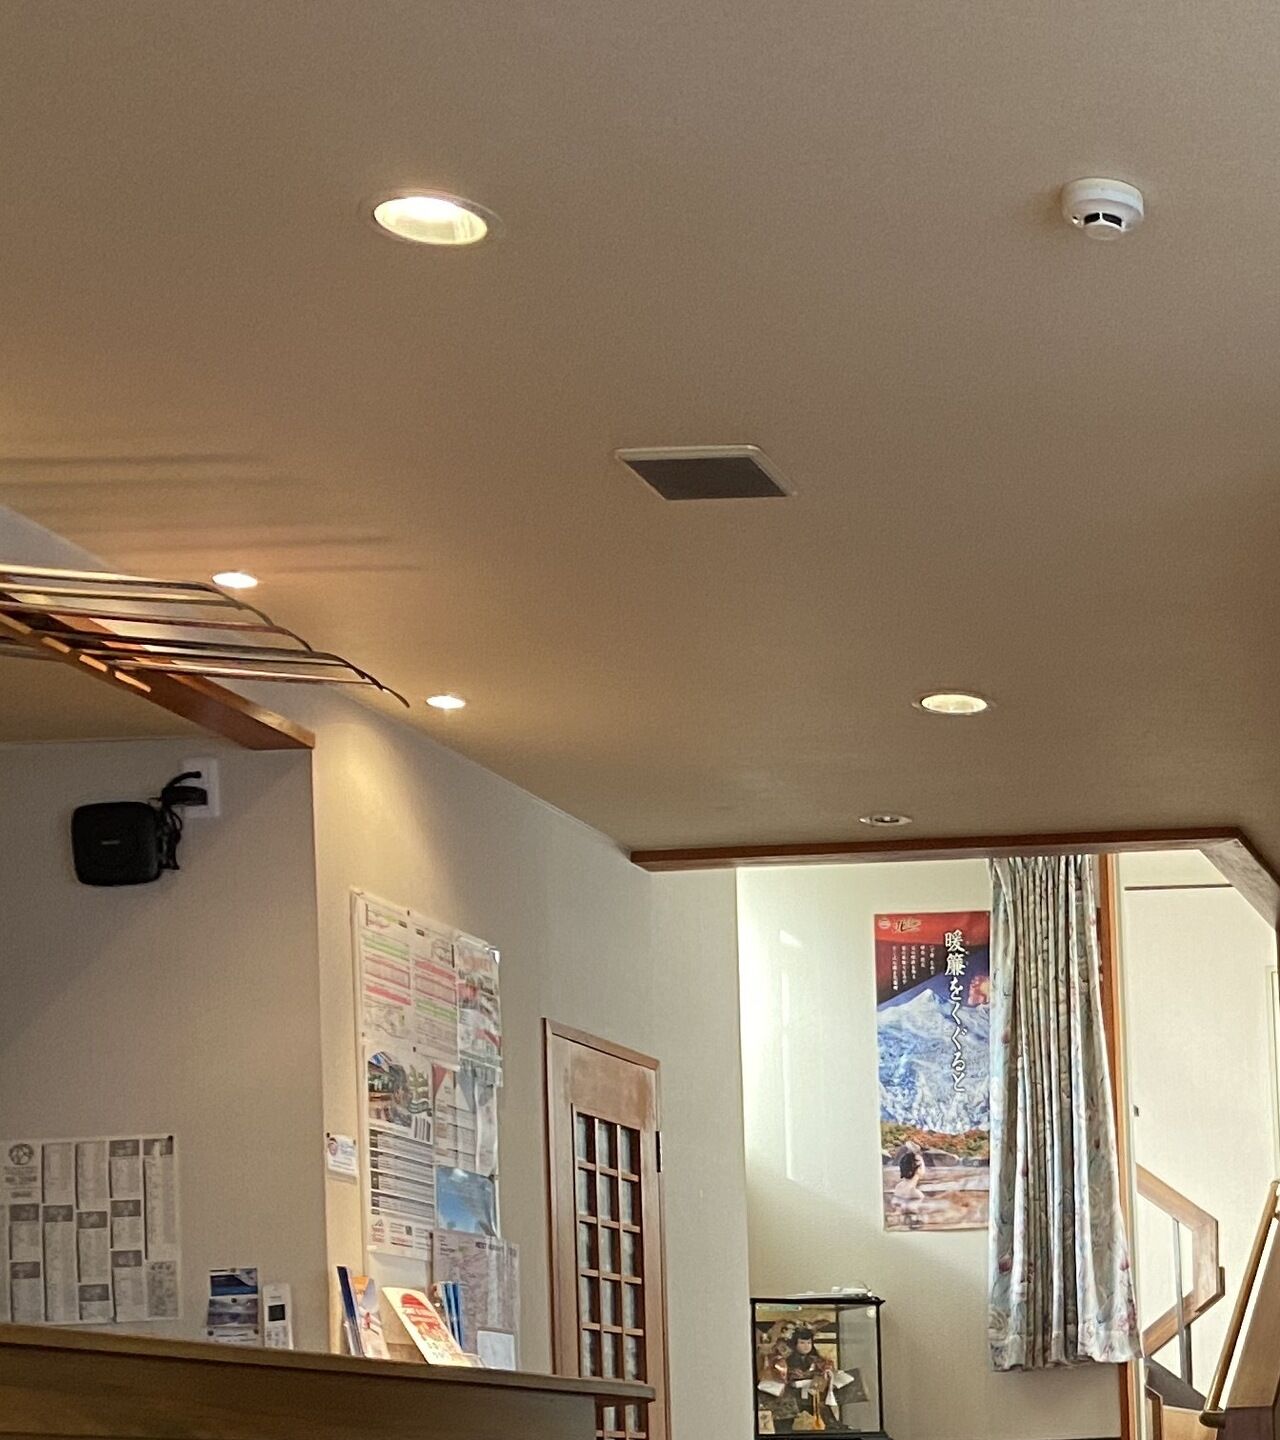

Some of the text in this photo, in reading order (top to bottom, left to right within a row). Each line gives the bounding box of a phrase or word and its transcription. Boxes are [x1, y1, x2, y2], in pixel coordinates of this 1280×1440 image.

[945, 929, 967, 1092] 暖簾をくぐると
